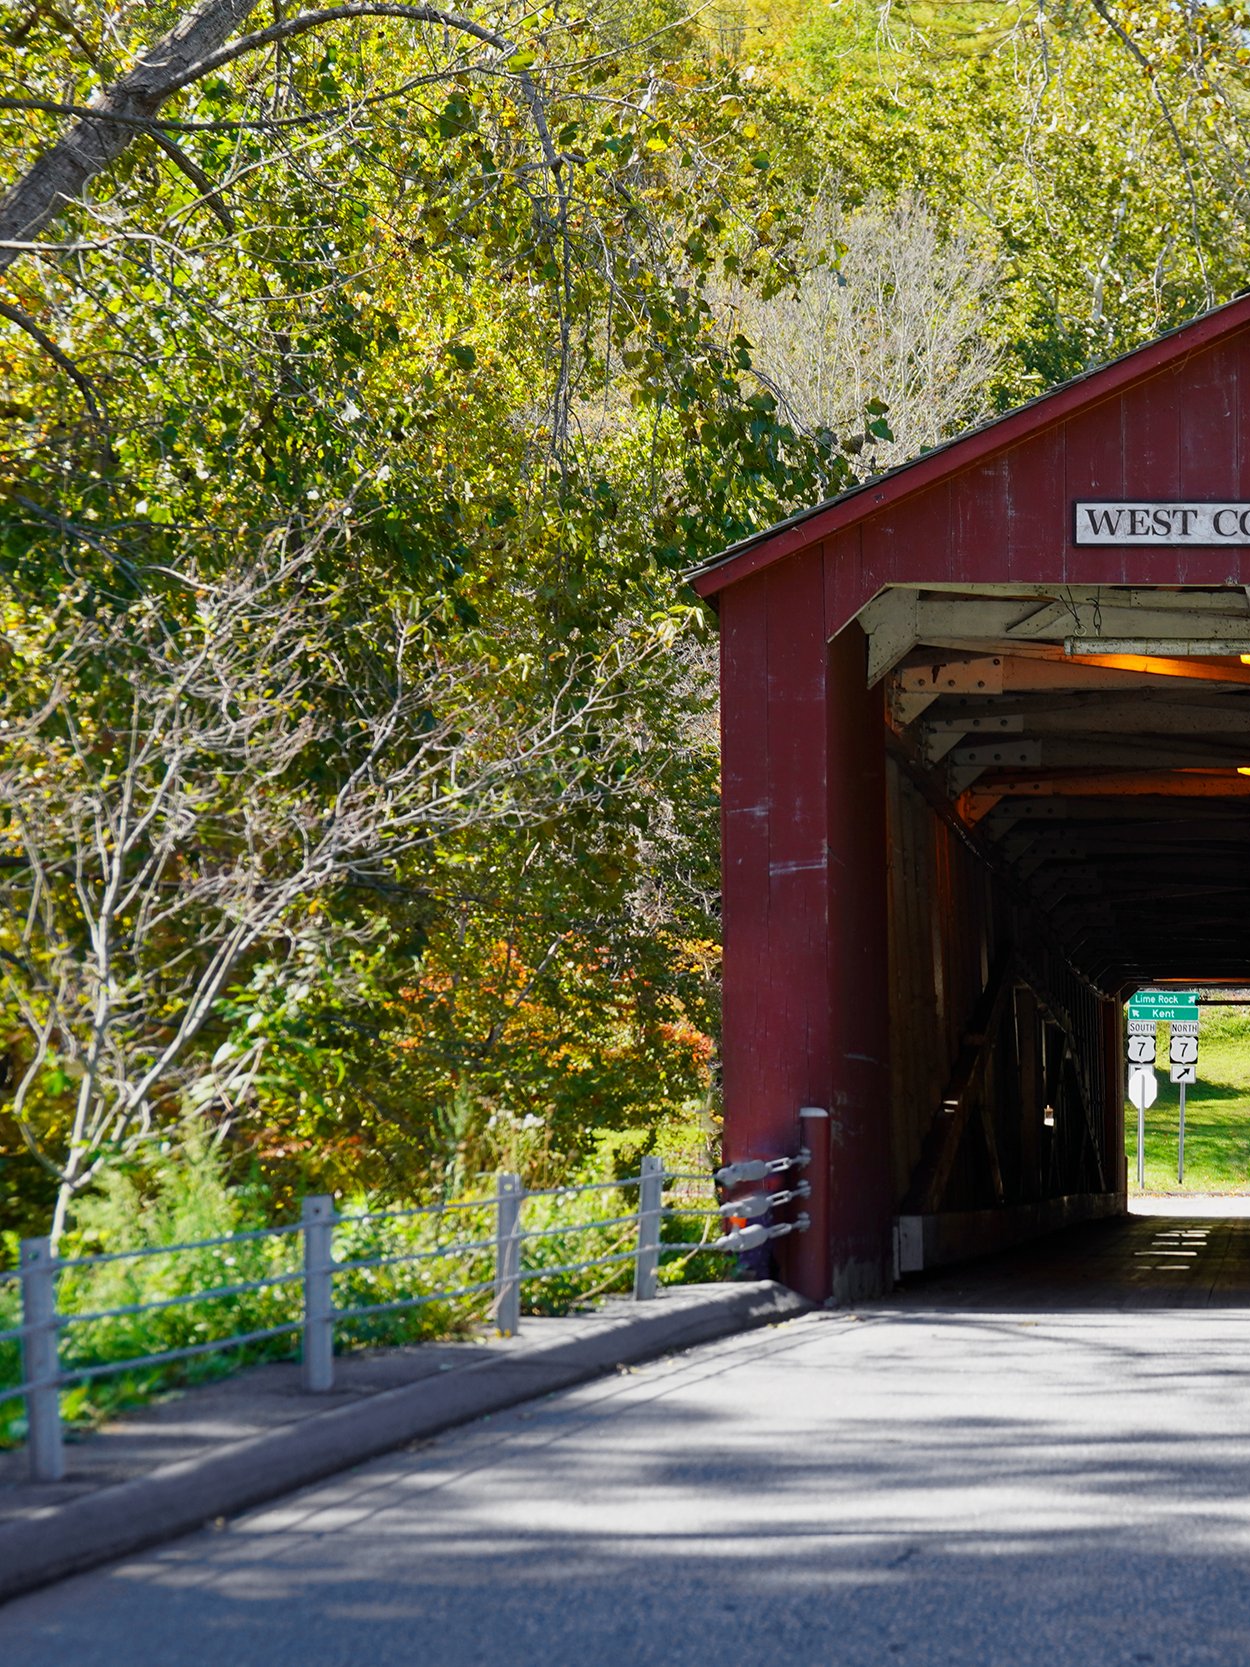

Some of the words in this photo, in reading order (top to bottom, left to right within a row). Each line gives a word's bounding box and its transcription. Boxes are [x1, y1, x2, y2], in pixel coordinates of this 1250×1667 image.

[1085, 508, 1198, 537] WEST
[1135, 994, 1156, 1004] Lime
[1158, 994, 1179, 1004] Rock
[1152, 1009, 1175, 1018] Kent
[1130, 1022, 1155, 1032] SOUTH
[1172, 1023, 1197, 1032] NORTH
[1137, 1042, 1146, 1057] 7
[1180, 1042, 1188, 1058] 7
